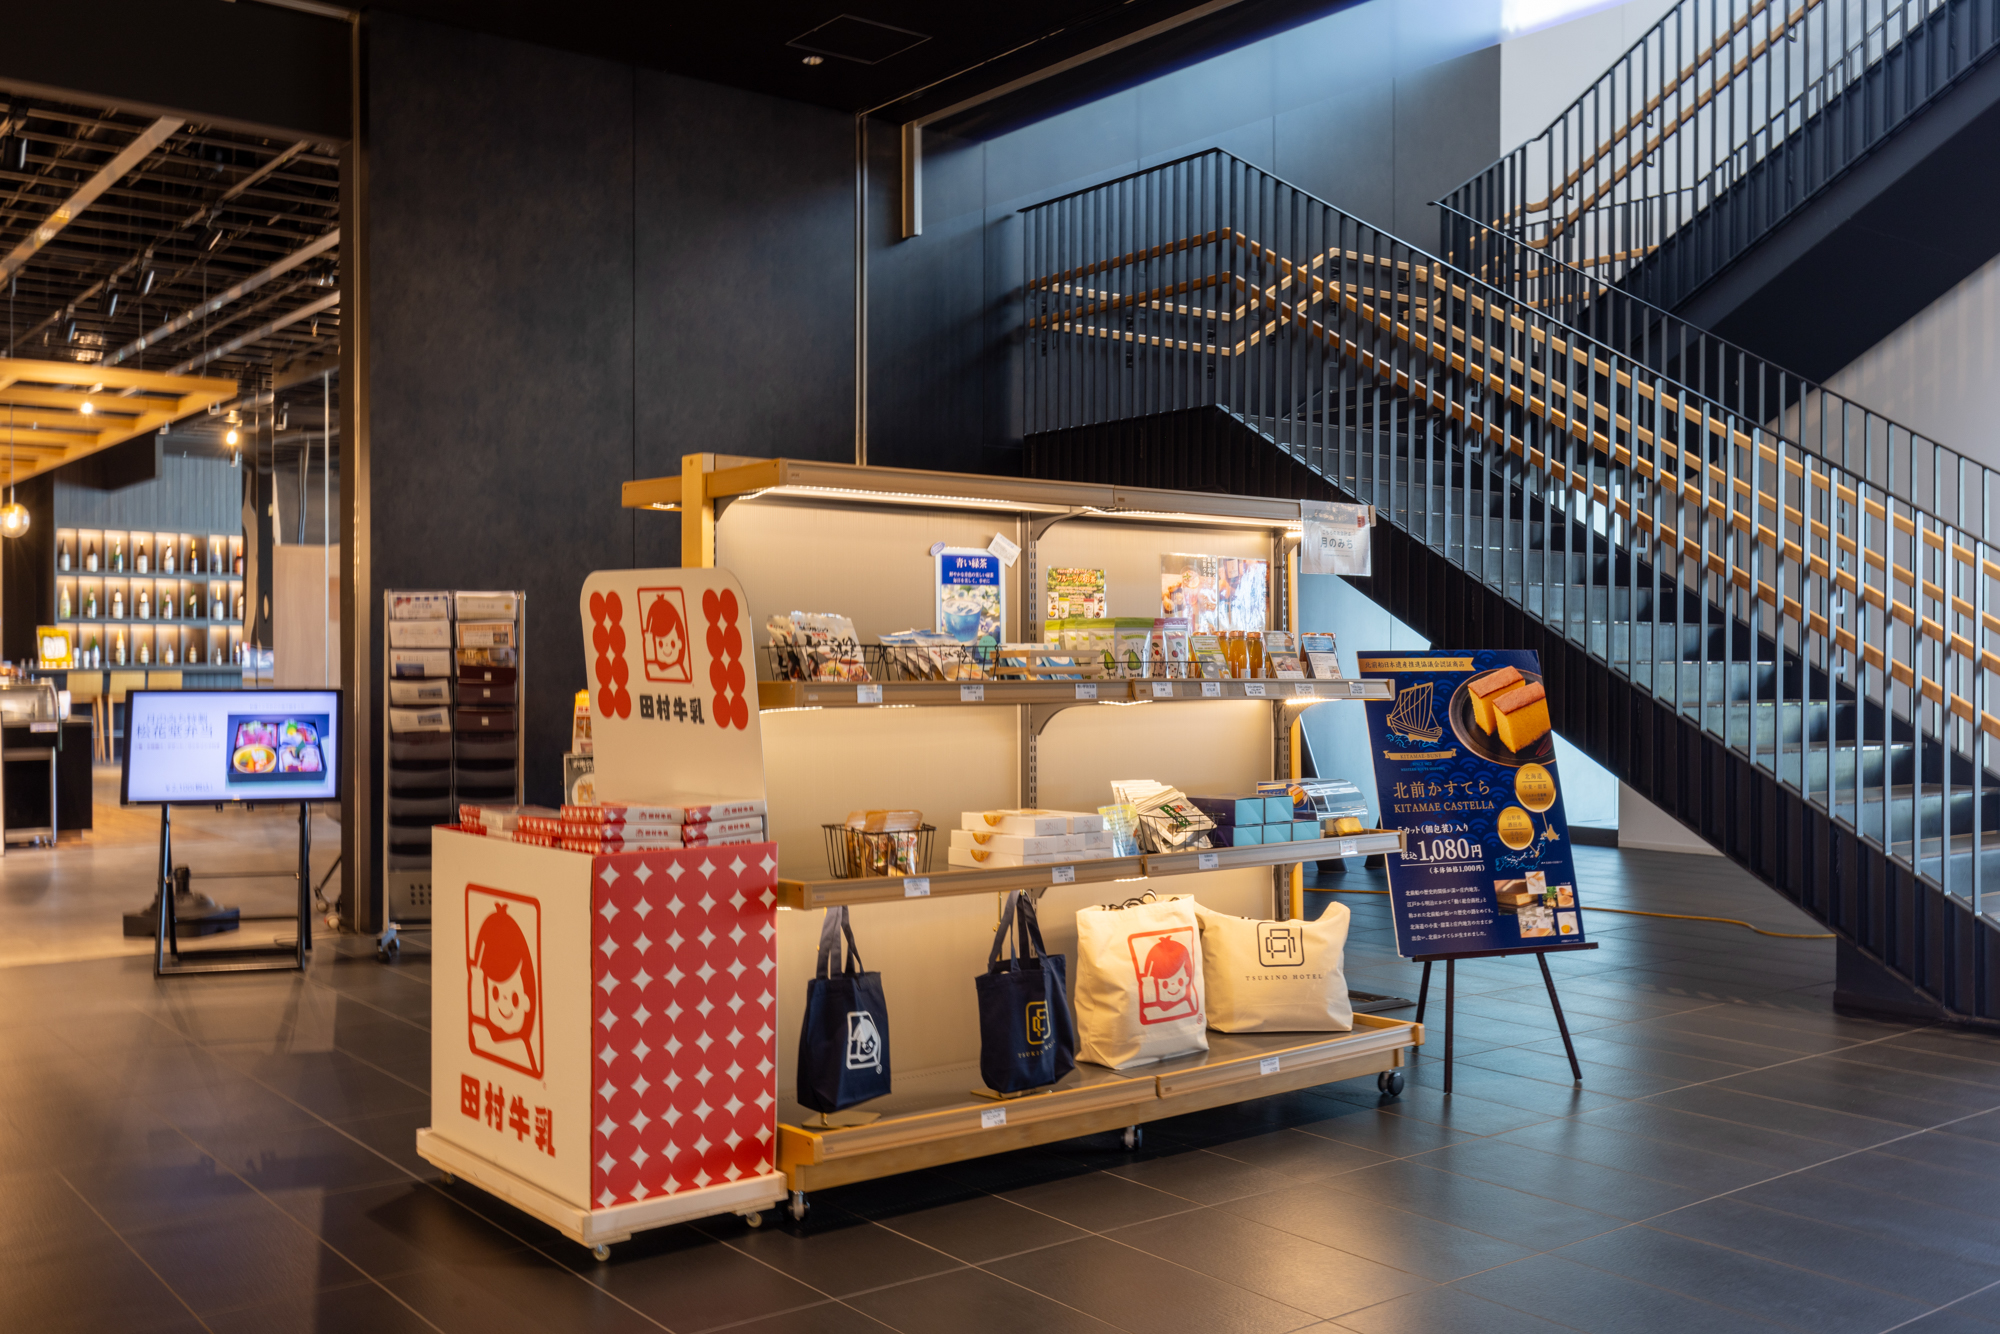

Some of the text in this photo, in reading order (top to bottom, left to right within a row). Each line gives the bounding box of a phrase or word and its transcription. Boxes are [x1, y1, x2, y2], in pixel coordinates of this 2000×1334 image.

[1320, 537, 1353, 549] 月のみち
[955, 557, 987, 569] 青い緑茶
[639, 693, 705, 725] 田村牛乳
[1393, 779, 1490, 799] 北前かすてら
[1393, 800, 1495, 813] KITAMAE CASTELLA
[460, 1072, 556, 1159] 田村牛乳
